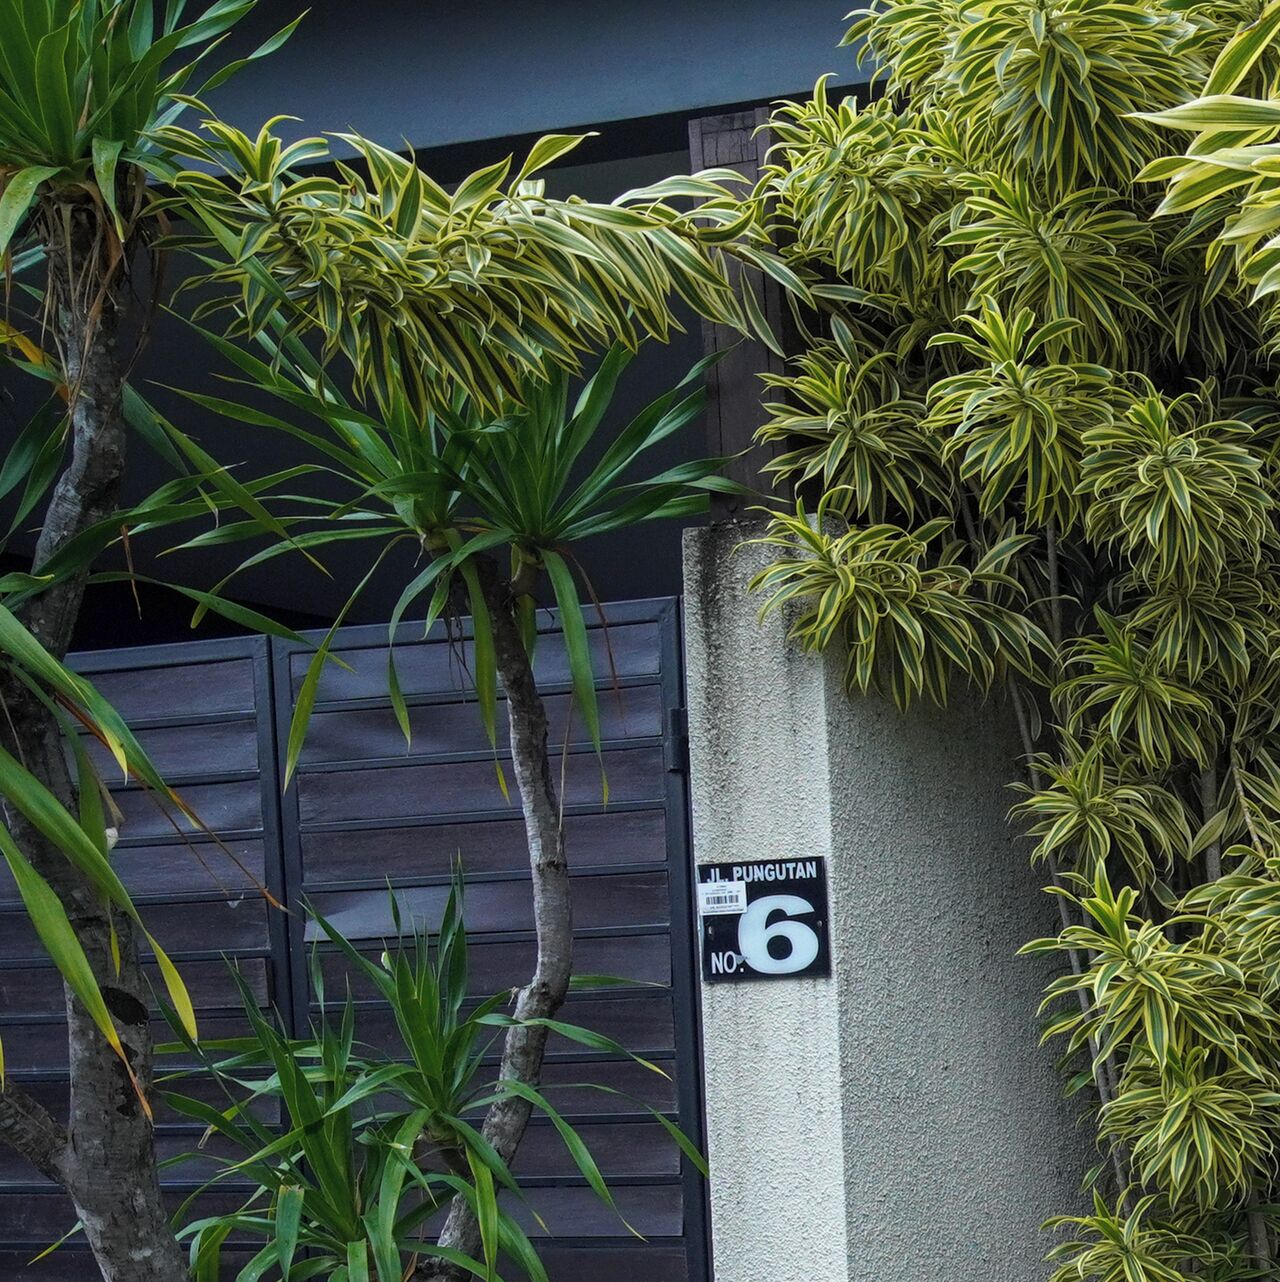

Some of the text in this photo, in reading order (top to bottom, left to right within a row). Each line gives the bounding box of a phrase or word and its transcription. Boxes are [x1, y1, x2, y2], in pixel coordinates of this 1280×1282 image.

[733, 861, 816, 882] PUNGUTAN
[711, 952, 744, 974] NO.
[738, 894, 818, 974] 6
